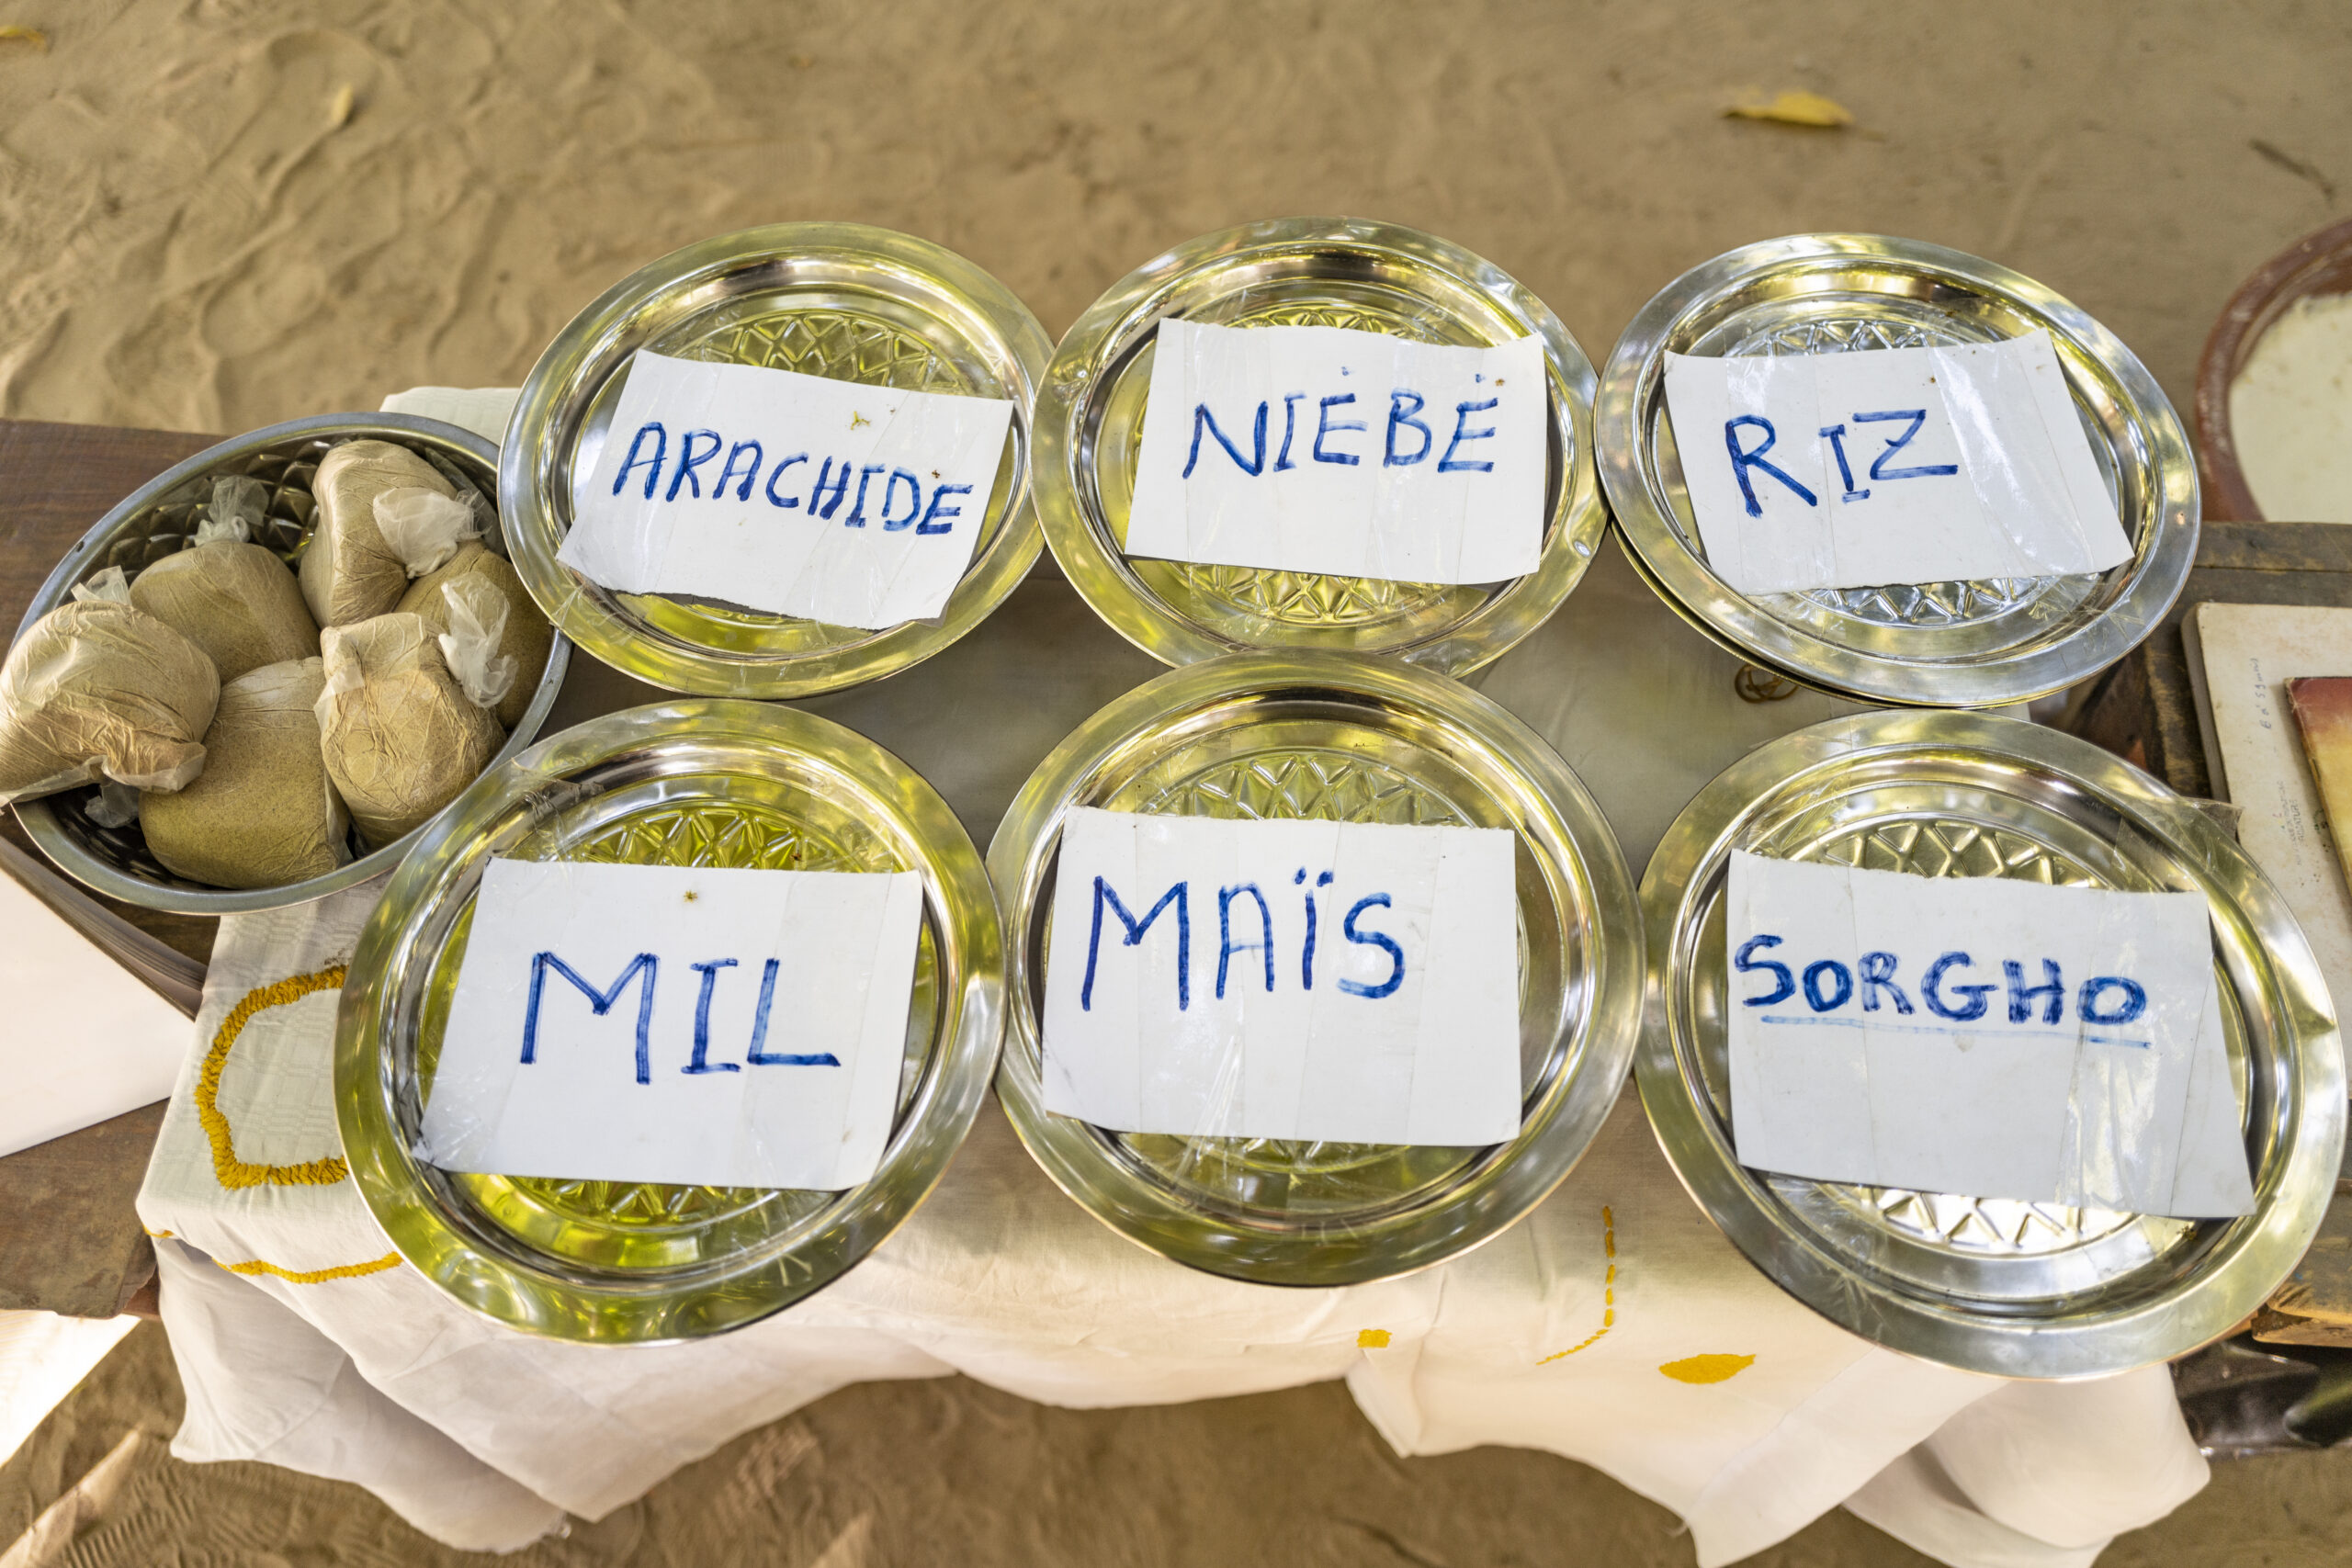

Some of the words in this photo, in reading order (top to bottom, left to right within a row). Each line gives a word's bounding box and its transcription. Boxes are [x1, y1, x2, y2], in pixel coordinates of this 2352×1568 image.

[613, 423, 973, 535] ARACHIDE
[1725, 410, 1958, 517] RIZ
[1082, 867, 1404, 1010] MAÏS
[1736, 935, 2147, 1025] SORGHO
[521, 952, 840, 1084] MIL
